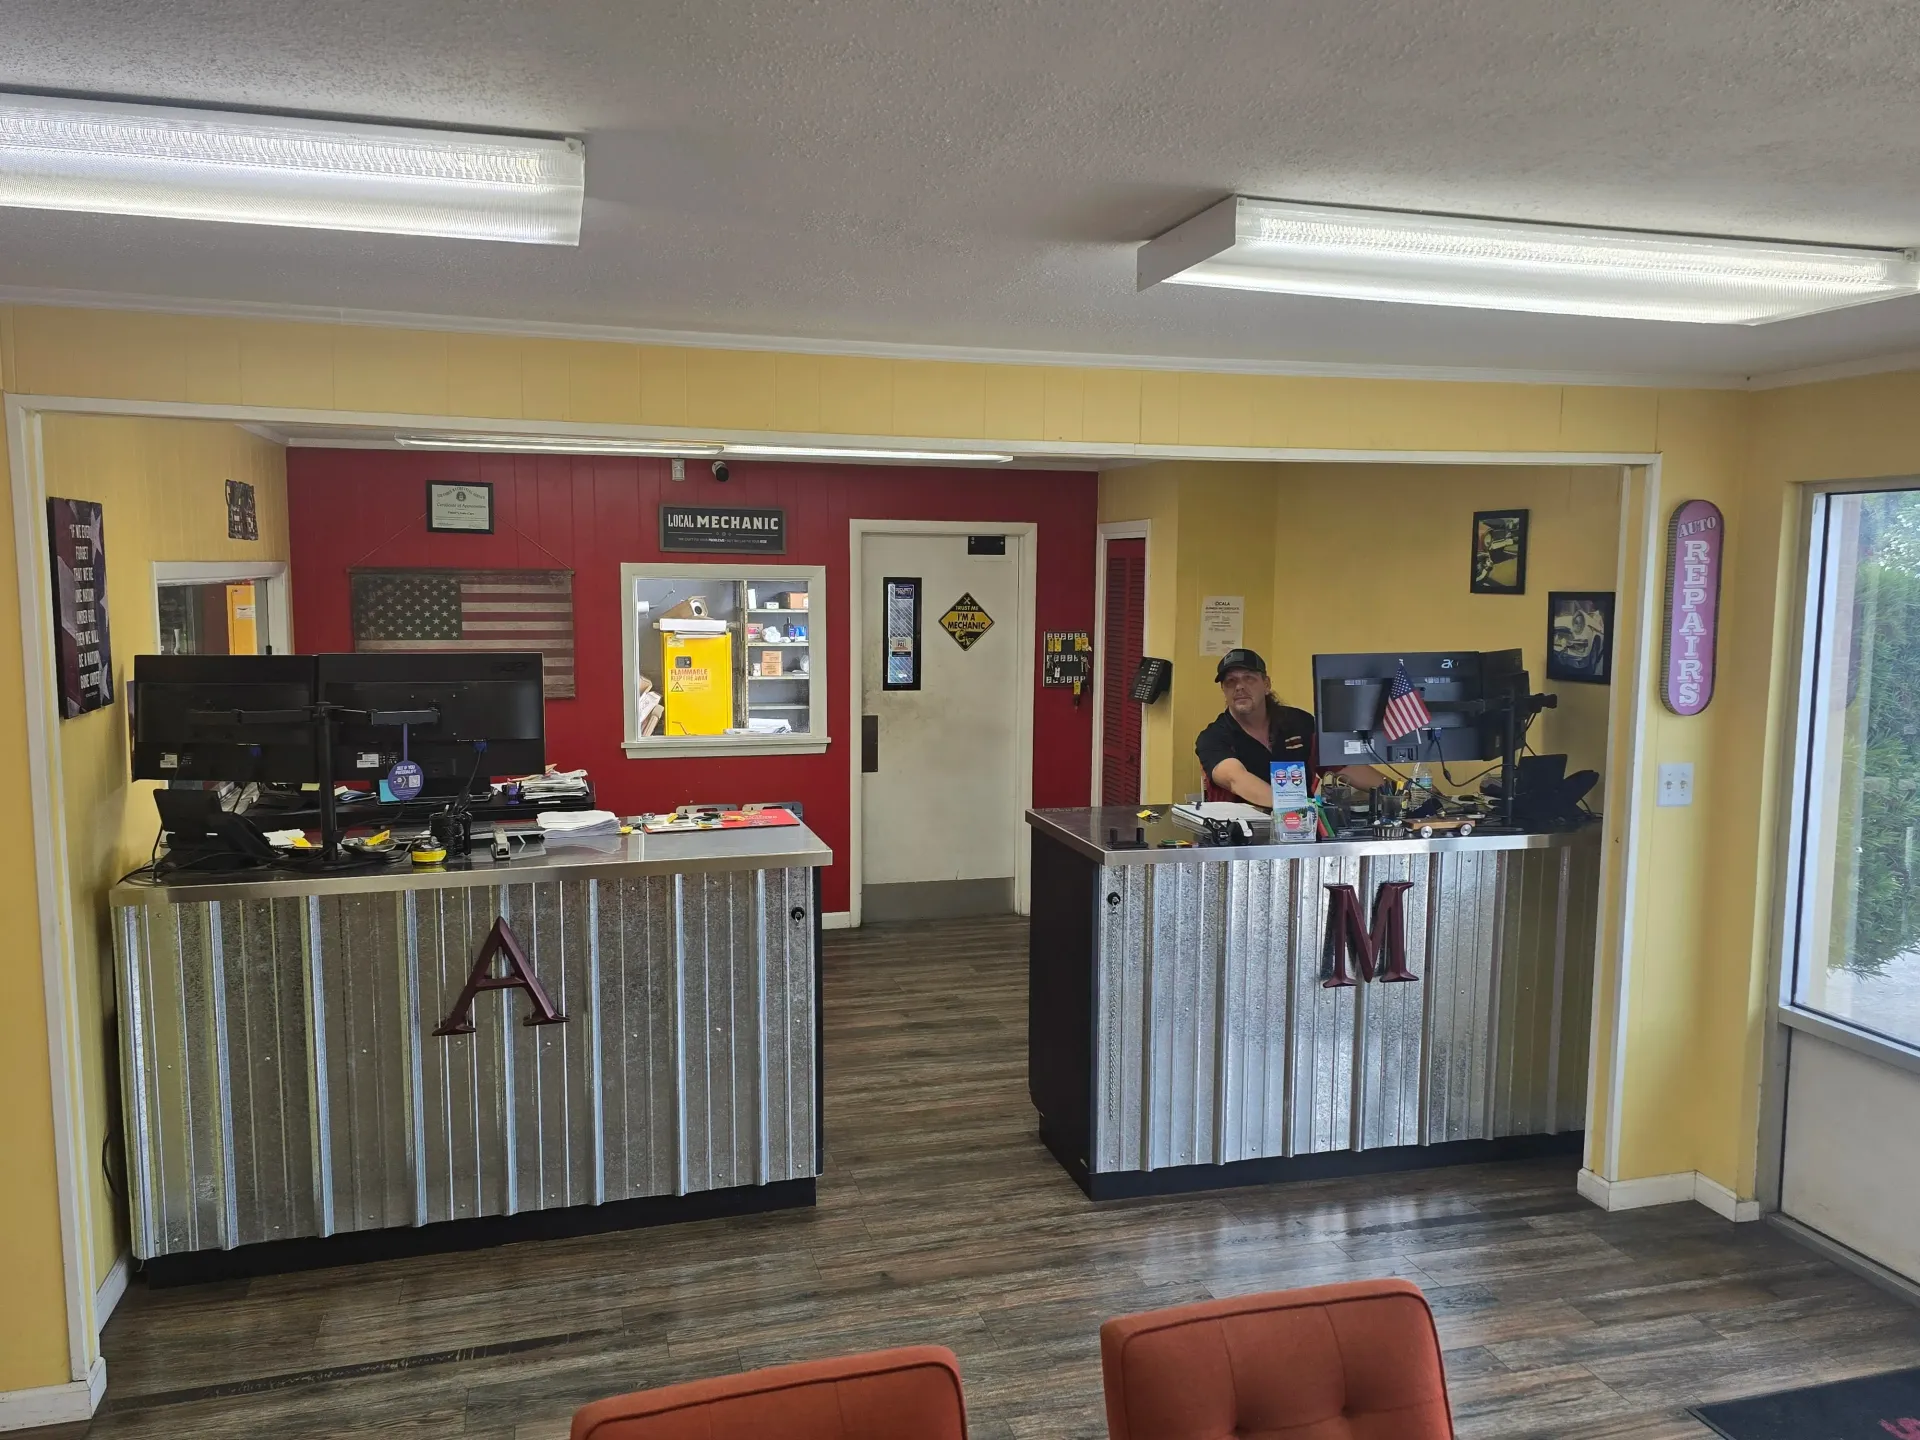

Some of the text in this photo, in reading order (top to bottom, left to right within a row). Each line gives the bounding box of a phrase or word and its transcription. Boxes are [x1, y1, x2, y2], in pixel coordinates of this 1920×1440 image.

[668, 514, 779, 530] LOCAL MECHANIC
[1678, 516, 1717, 538] AUTO
[947, 621, 986, 630] MECHANIC
[957, 613, 976, 622] I'M A
[1677, 540, 1710, 707] REPAIRS
[1322, 881, 1420, 988] M
[432, 915, 570, 1036] A
